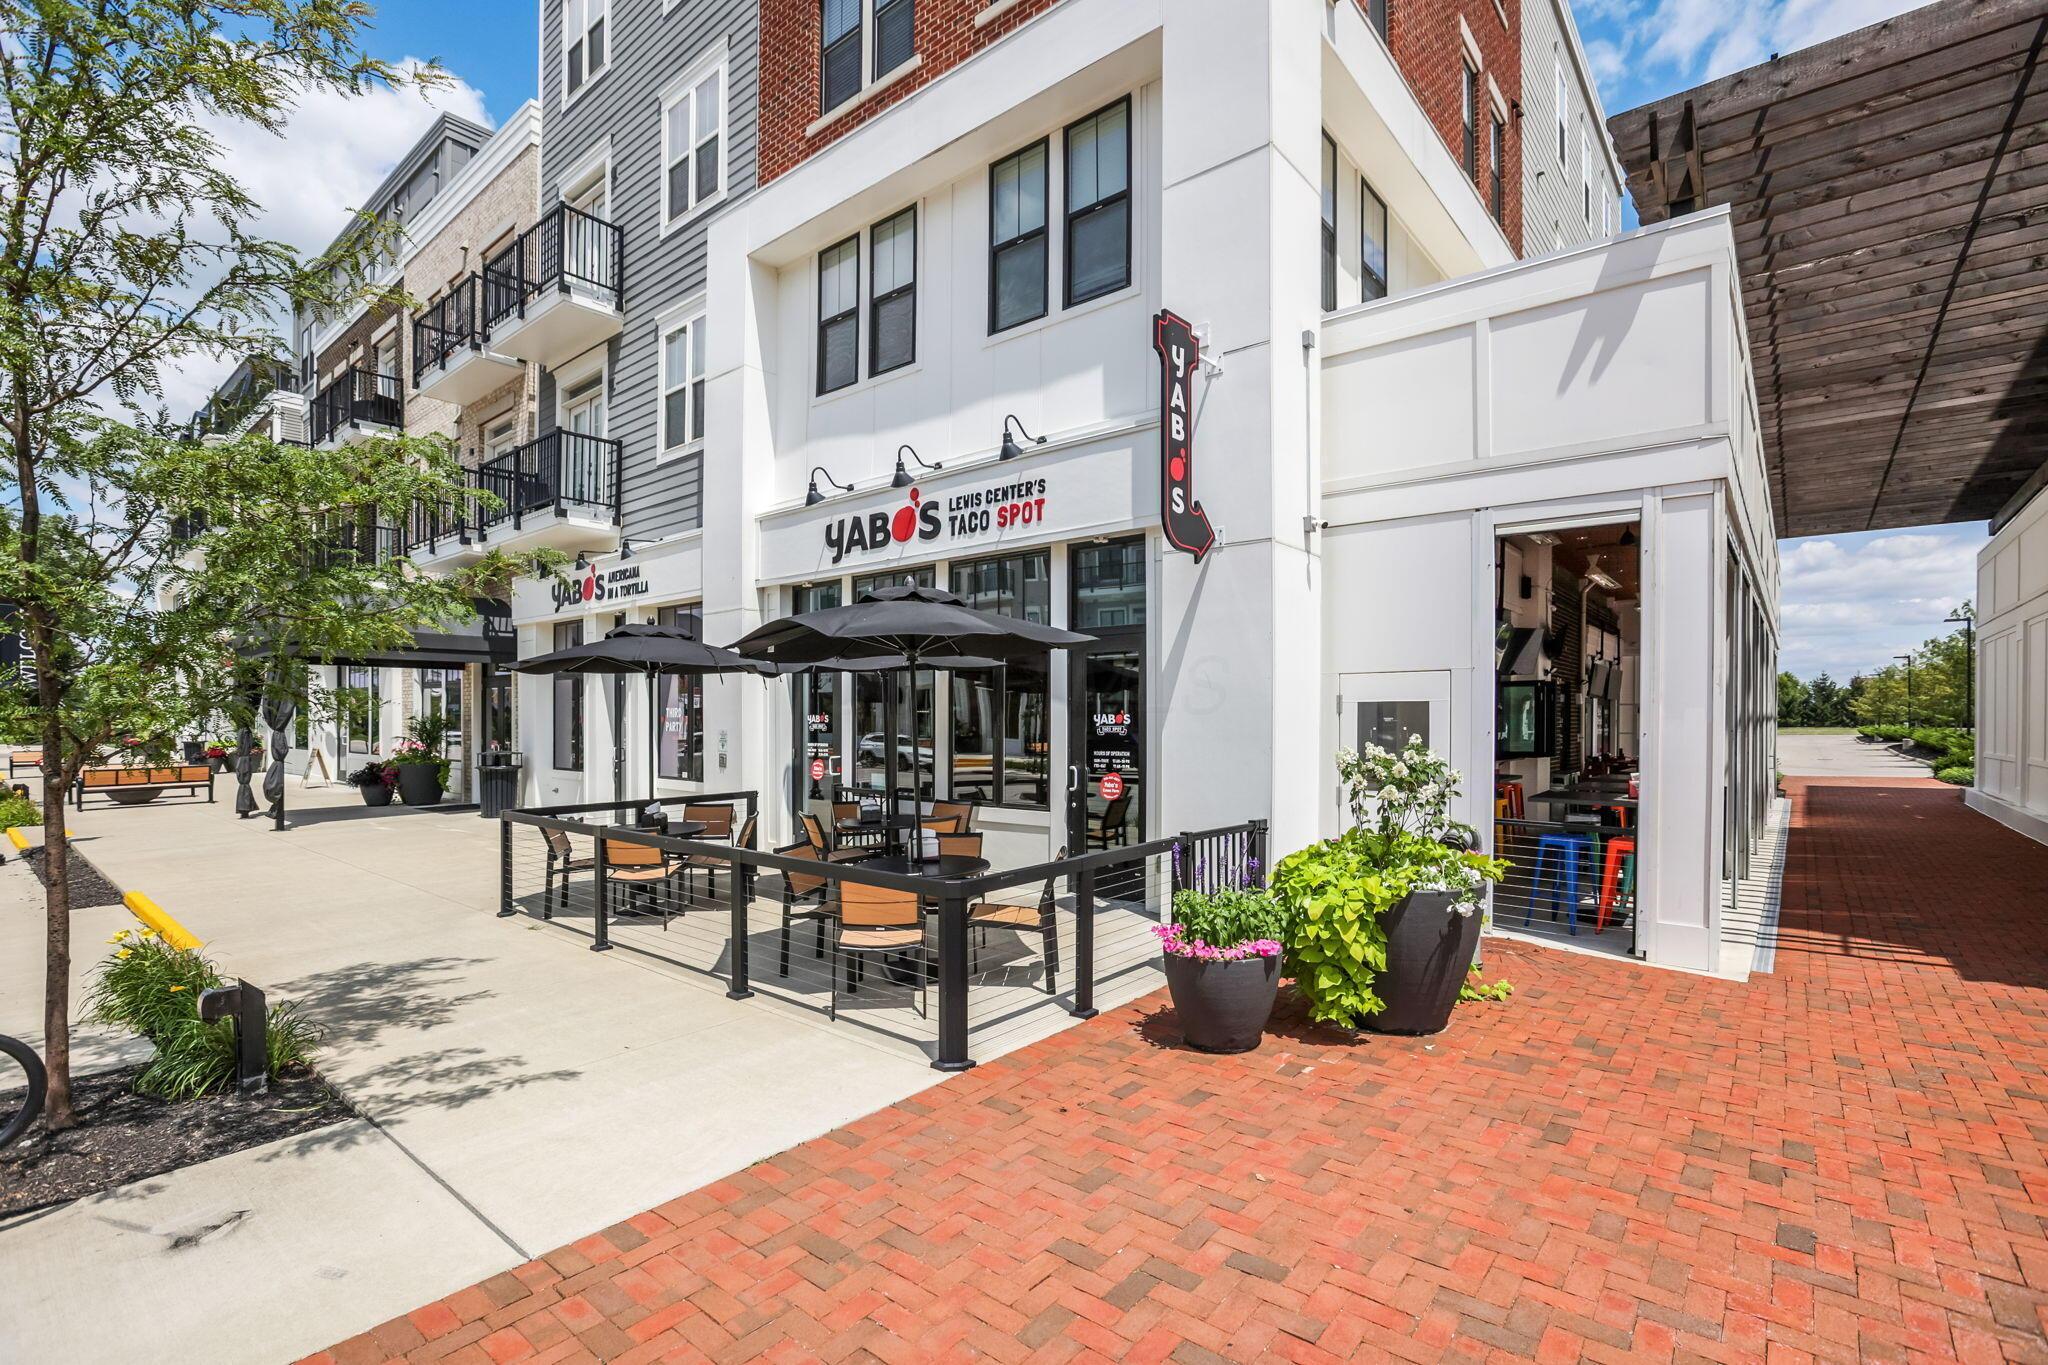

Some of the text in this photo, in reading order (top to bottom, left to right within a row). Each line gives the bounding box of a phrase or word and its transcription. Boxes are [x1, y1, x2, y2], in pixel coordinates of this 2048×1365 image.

[949, 478, 1046, 512] LEWIS CENTER'S
[825, 487, 942, 564] YABO'S
[948, 498, 1046, 537] TACO SPOT
[608, 565, 640, 583] AMERICANA
[614, 587, 619, 600] A
[620, 580, 649, 599] TORTILLA
[665, 721, 683, 732] PARTY
